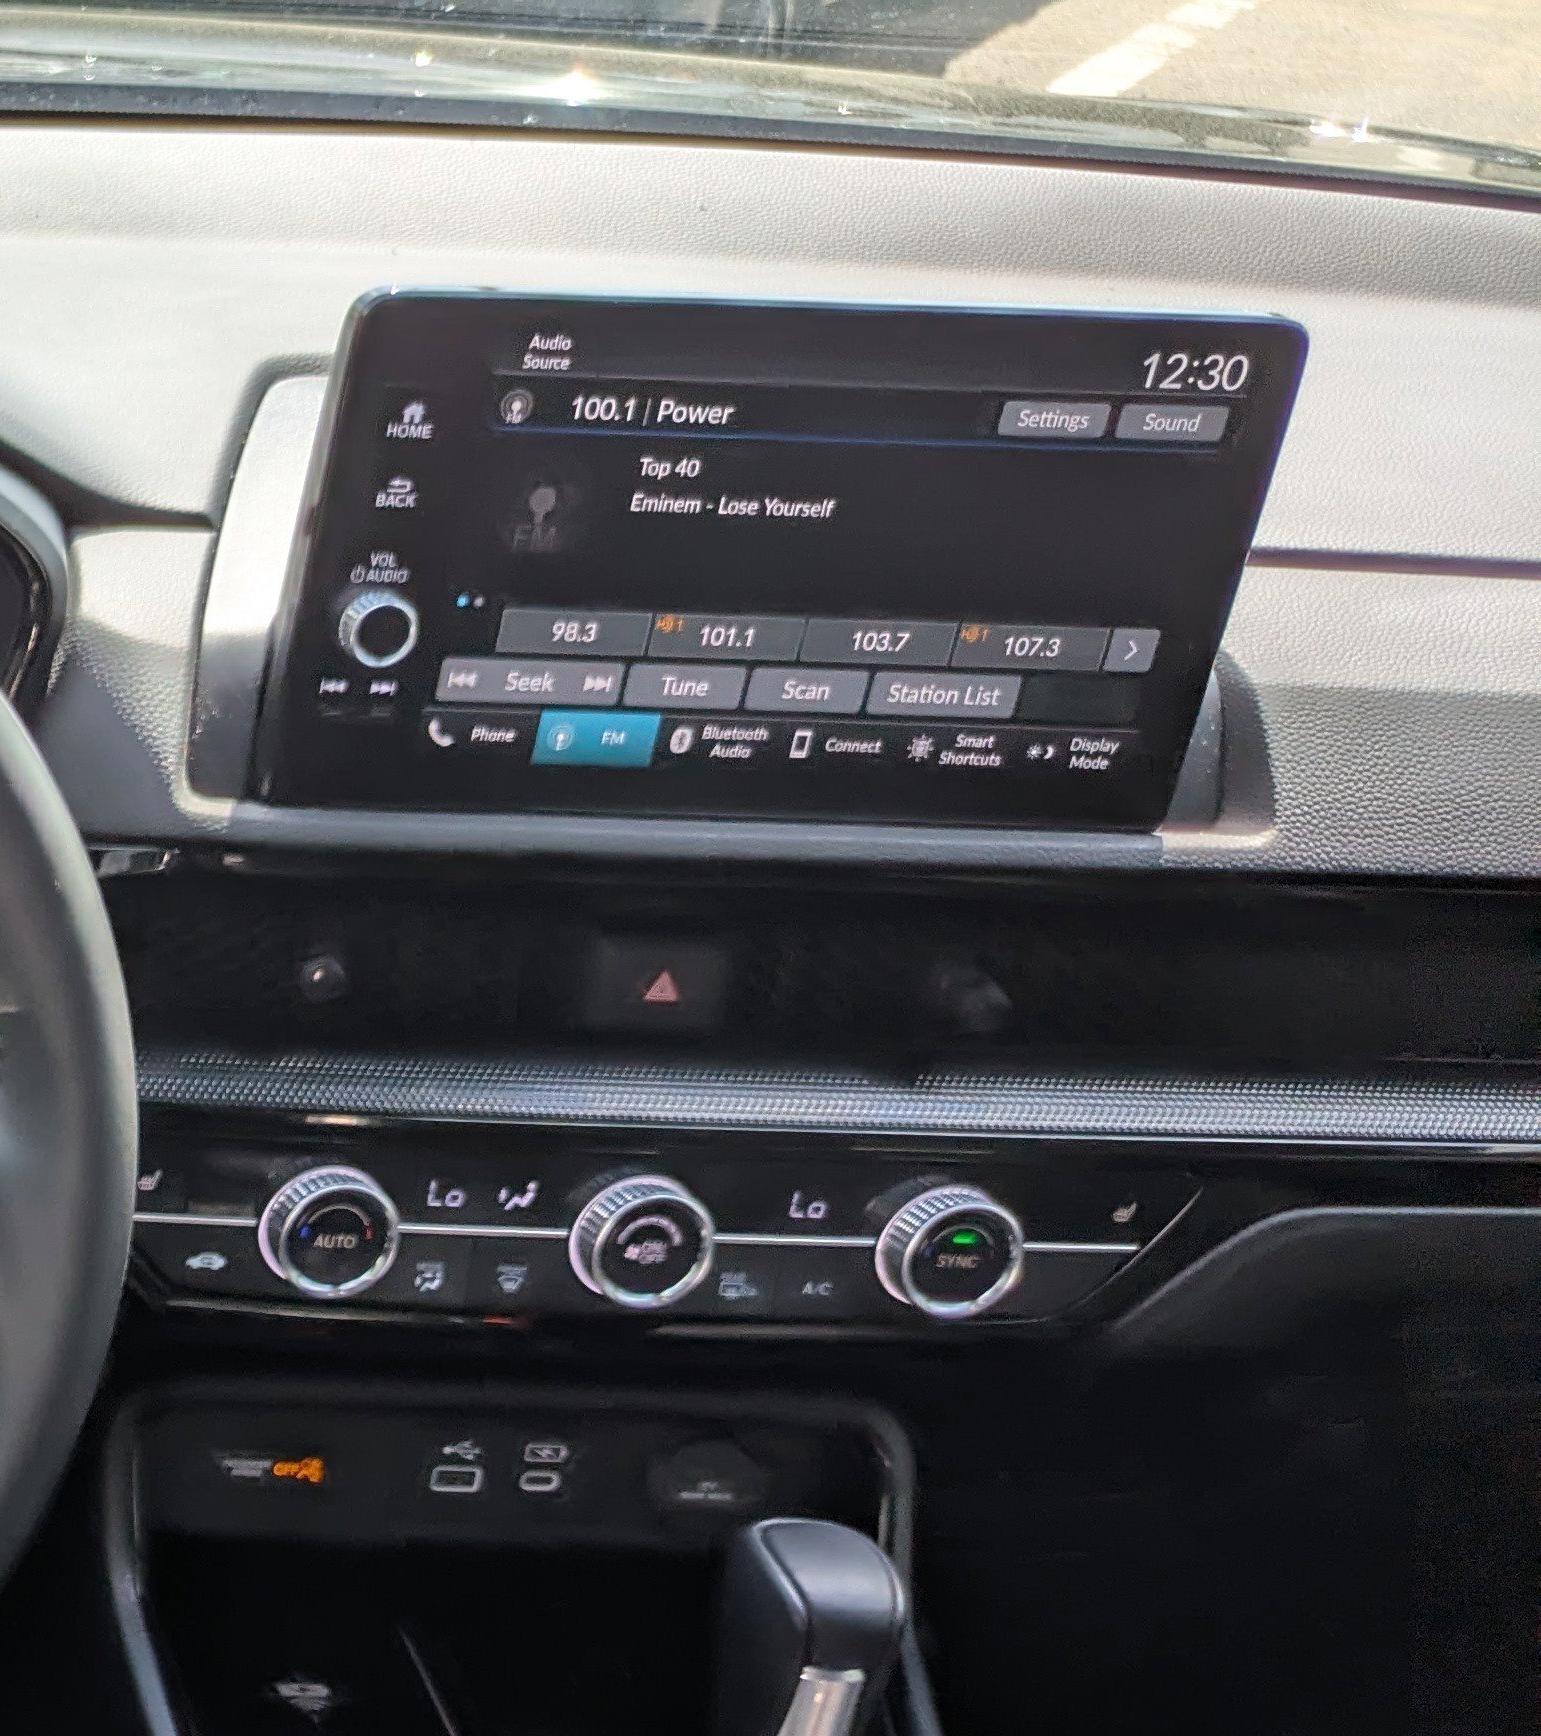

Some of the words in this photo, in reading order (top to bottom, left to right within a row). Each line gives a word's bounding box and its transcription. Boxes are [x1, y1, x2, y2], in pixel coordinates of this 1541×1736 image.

[529, 333, 572, 351] Audio
[522, 354, 571, 370] Source
[1143, 352, 1250, 392] 12:30
[571, 394, 636, 421] 100.1
[656, 399, 735, 425] Power
[1017, 409, 1090, 432] Settings
[1142, 412, 1203, 433] Sound
[386, 422, 434, 440] HOME
[640, 456, 671, 481] Top
[674, 457, 701, 478] 40
[375, 492, 417, 509] BACK
[630, 493, 703, 515] Eminem
[718, 496, 759, 517] Lose
[763, 497, 837, 519] Yourself
[370, 551, 399, 569] VOL
[366, 567, 410, 584] AUDIO
[552, 620, 599, 643] 98.3
[699, 625, 757, 648] 101.1
[851, 630, 911, 653] 103.7
[1004, 635, 1061, 658] 107.3
[505, 672, 555, 694] Seek
[661, 677, 709, 698] Tune
[782, 681, 830, 702] Scan
[887, 683, 959, 706] Station
[963, 686, 1002, 707] List
[470, 725, 517, 744] Phone
[601, 731, 627, 746] FM
[702, 724, 769, 742] Bluetooth
[955, 733, 995, 750] Smart
[709, 743, 753, 760] Audio
[825, 737, 882, 755] Connect
[1070, 737, 1121, 756] Display
[939, 751, 1002, 768] Shortcuts
[1070, 754, 1111, 771] Mode
[313, 1233, 359, 1250] AUTO
